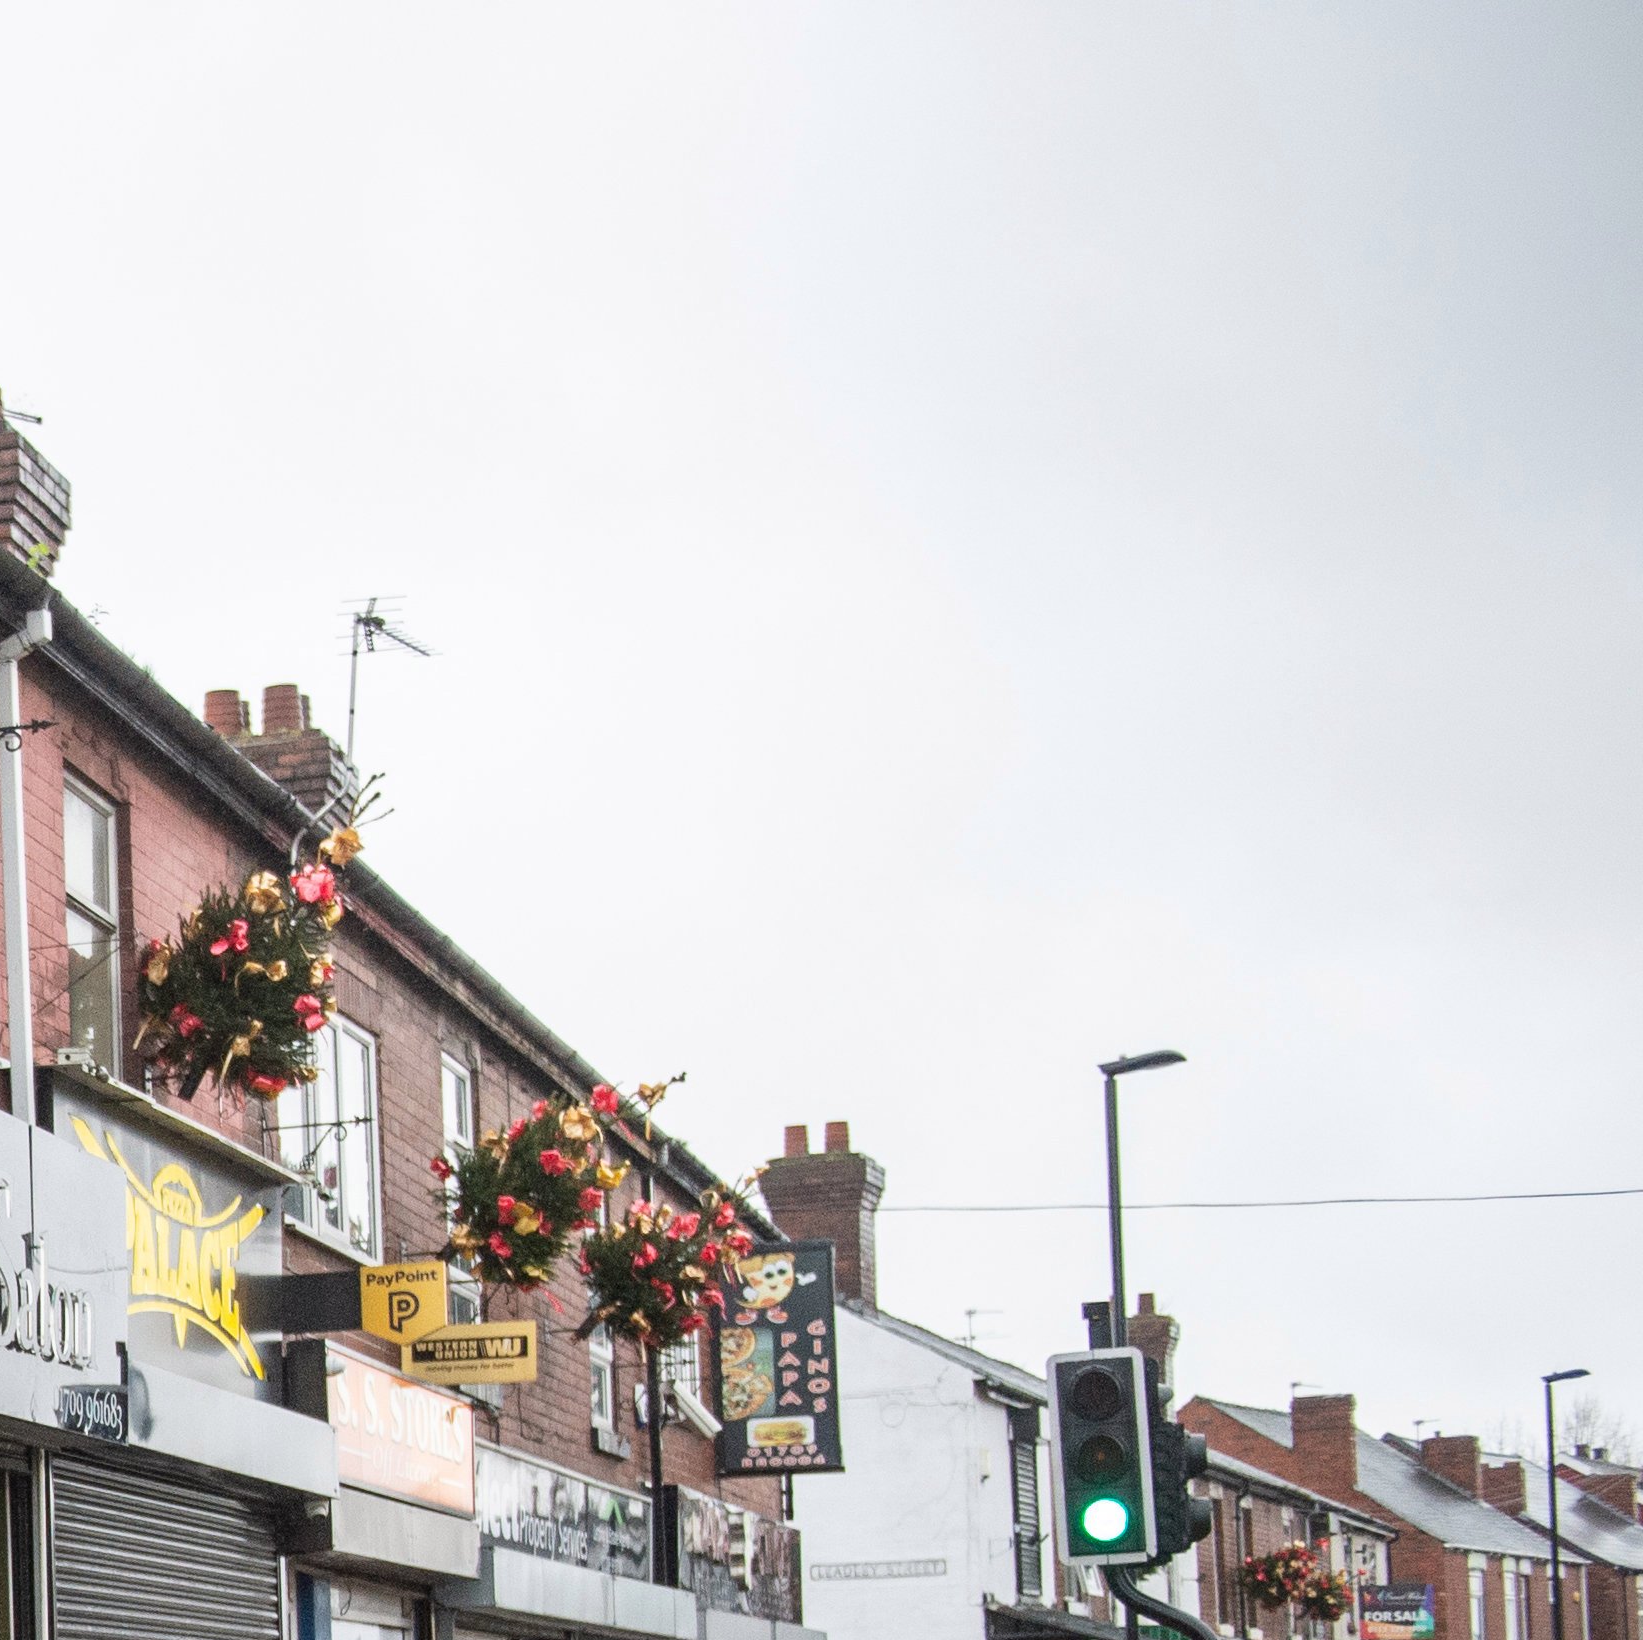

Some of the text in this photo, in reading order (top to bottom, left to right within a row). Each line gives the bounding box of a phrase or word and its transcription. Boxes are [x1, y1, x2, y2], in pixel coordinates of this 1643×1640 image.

[366, 1270, 438, 1287] PayPoint
[416, 1339, 478, 1352] WESTERN
[434, 1350, 478, 1360] UNION
[777, 1331, 803, 1407] PAPA
[86, 1388, 123, 1440] 961683
[389, 1382, 465, 1465] STORES
[1364, 1609, 1428, 1622] FOR SALE
